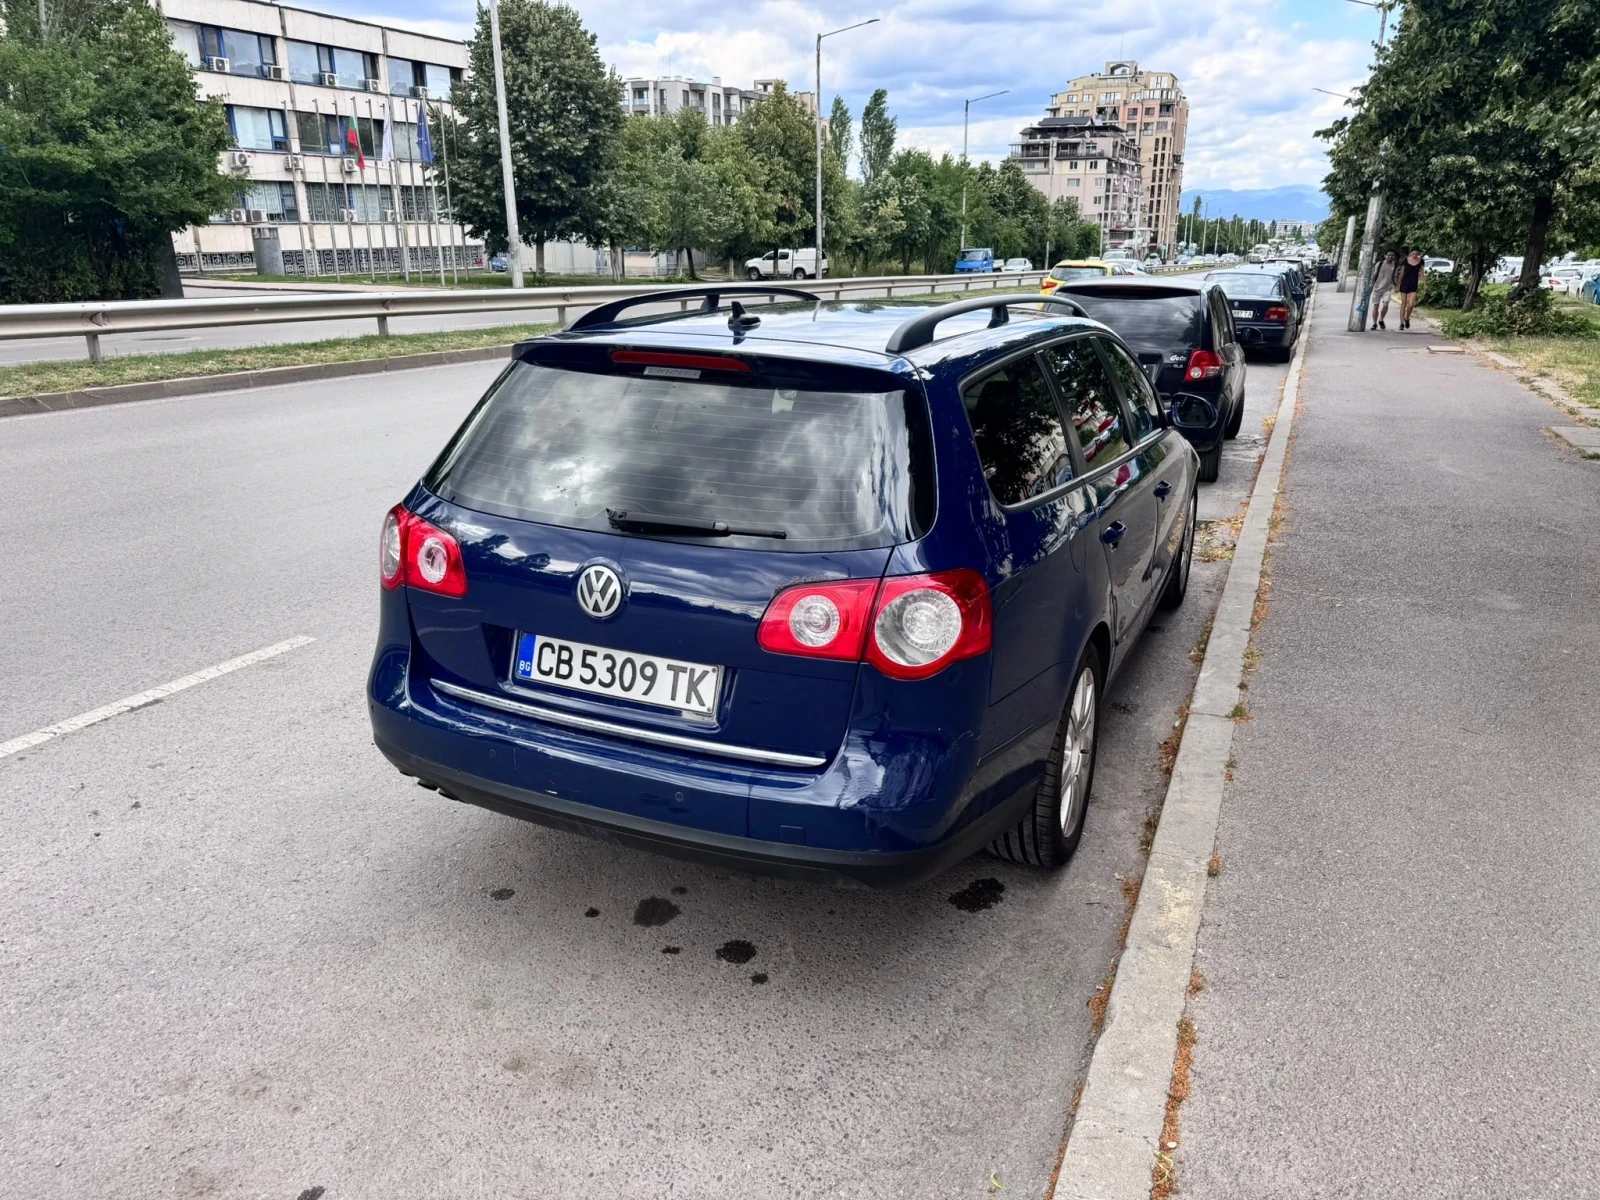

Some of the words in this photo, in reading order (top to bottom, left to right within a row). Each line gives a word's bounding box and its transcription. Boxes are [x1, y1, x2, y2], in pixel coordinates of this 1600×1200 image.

[577, 565, 622, 617] VW
[519, 660, 531, 671] BG
[579, 649, 658, 696] 5309
[666, 663, 710, 707] TK
